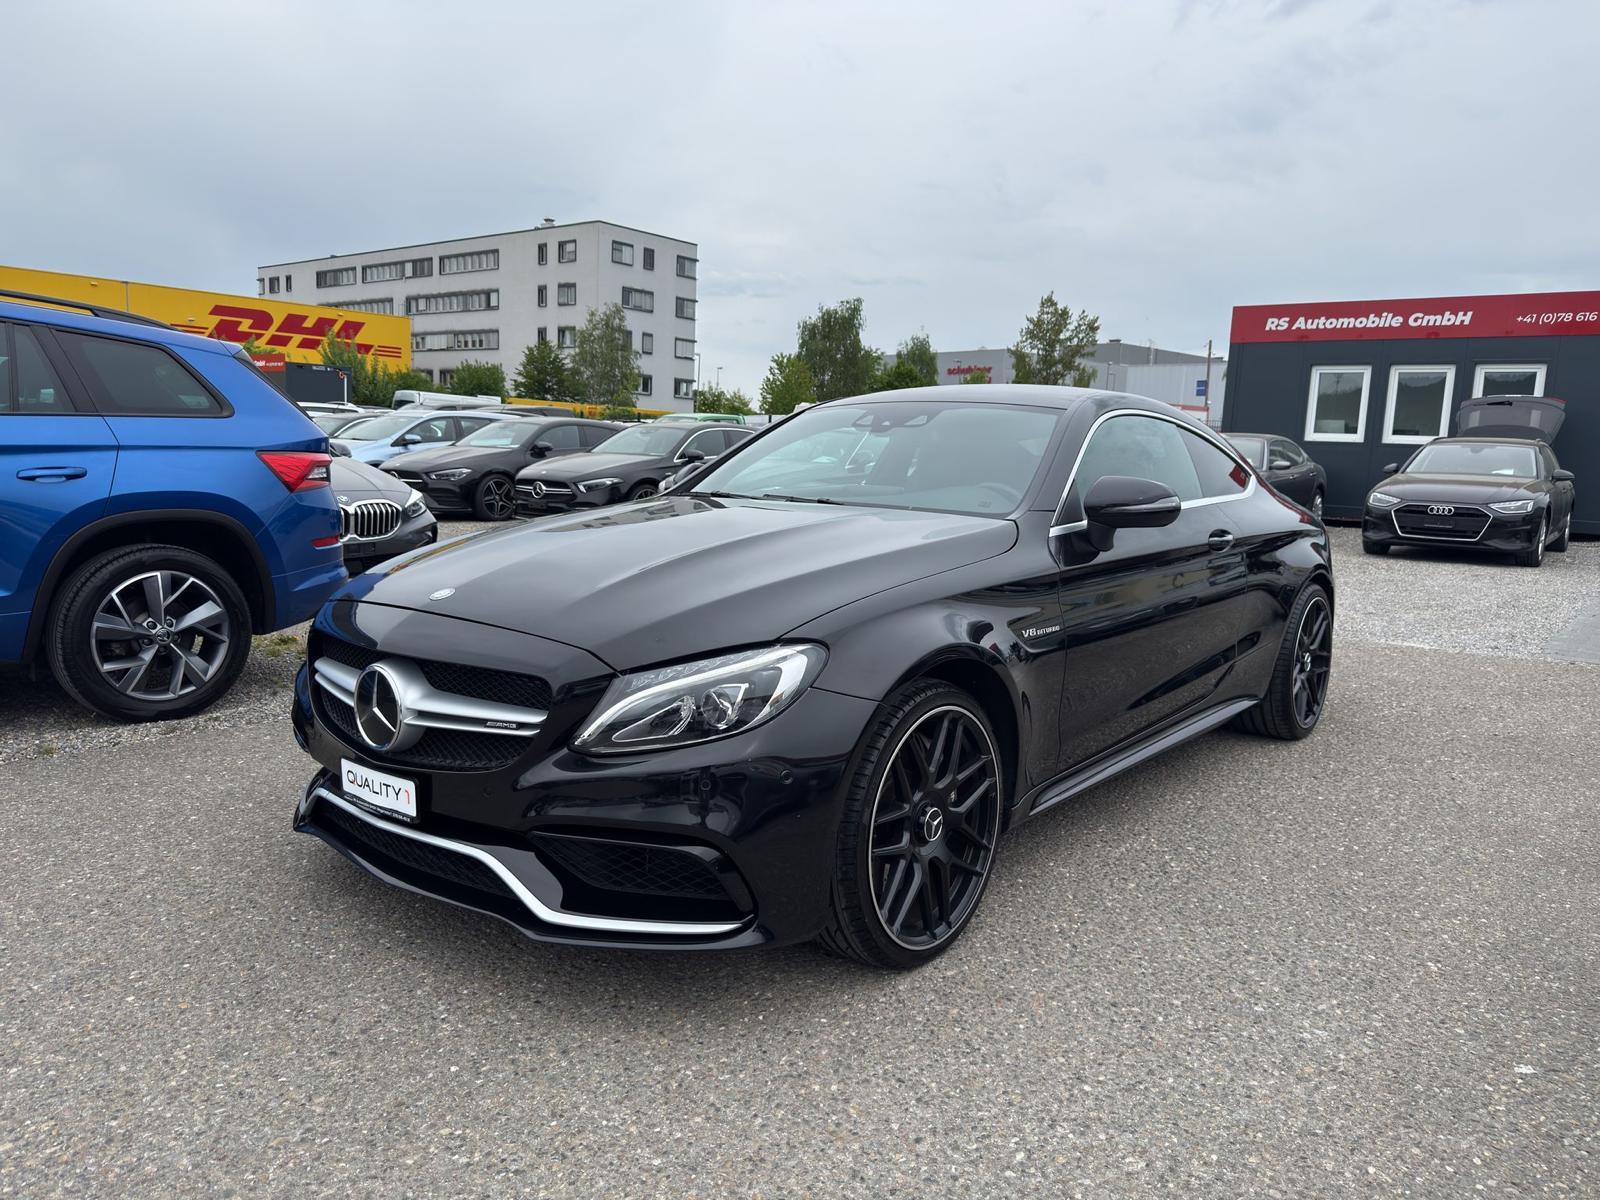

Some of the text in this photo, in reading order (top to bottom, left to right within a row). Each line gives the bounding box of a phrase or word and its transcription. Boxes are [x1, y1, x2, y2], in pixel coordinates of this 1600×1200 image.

[1265, 311, 1473, 331] RS Automobile GmbH
[1516, 311, 1599, 325] +41 (0)78 616
[207, 304, 375, 355] DHL
[1021, 628, 1036, 638] V8
[346, 769, 411, 805] QUALITY 1
